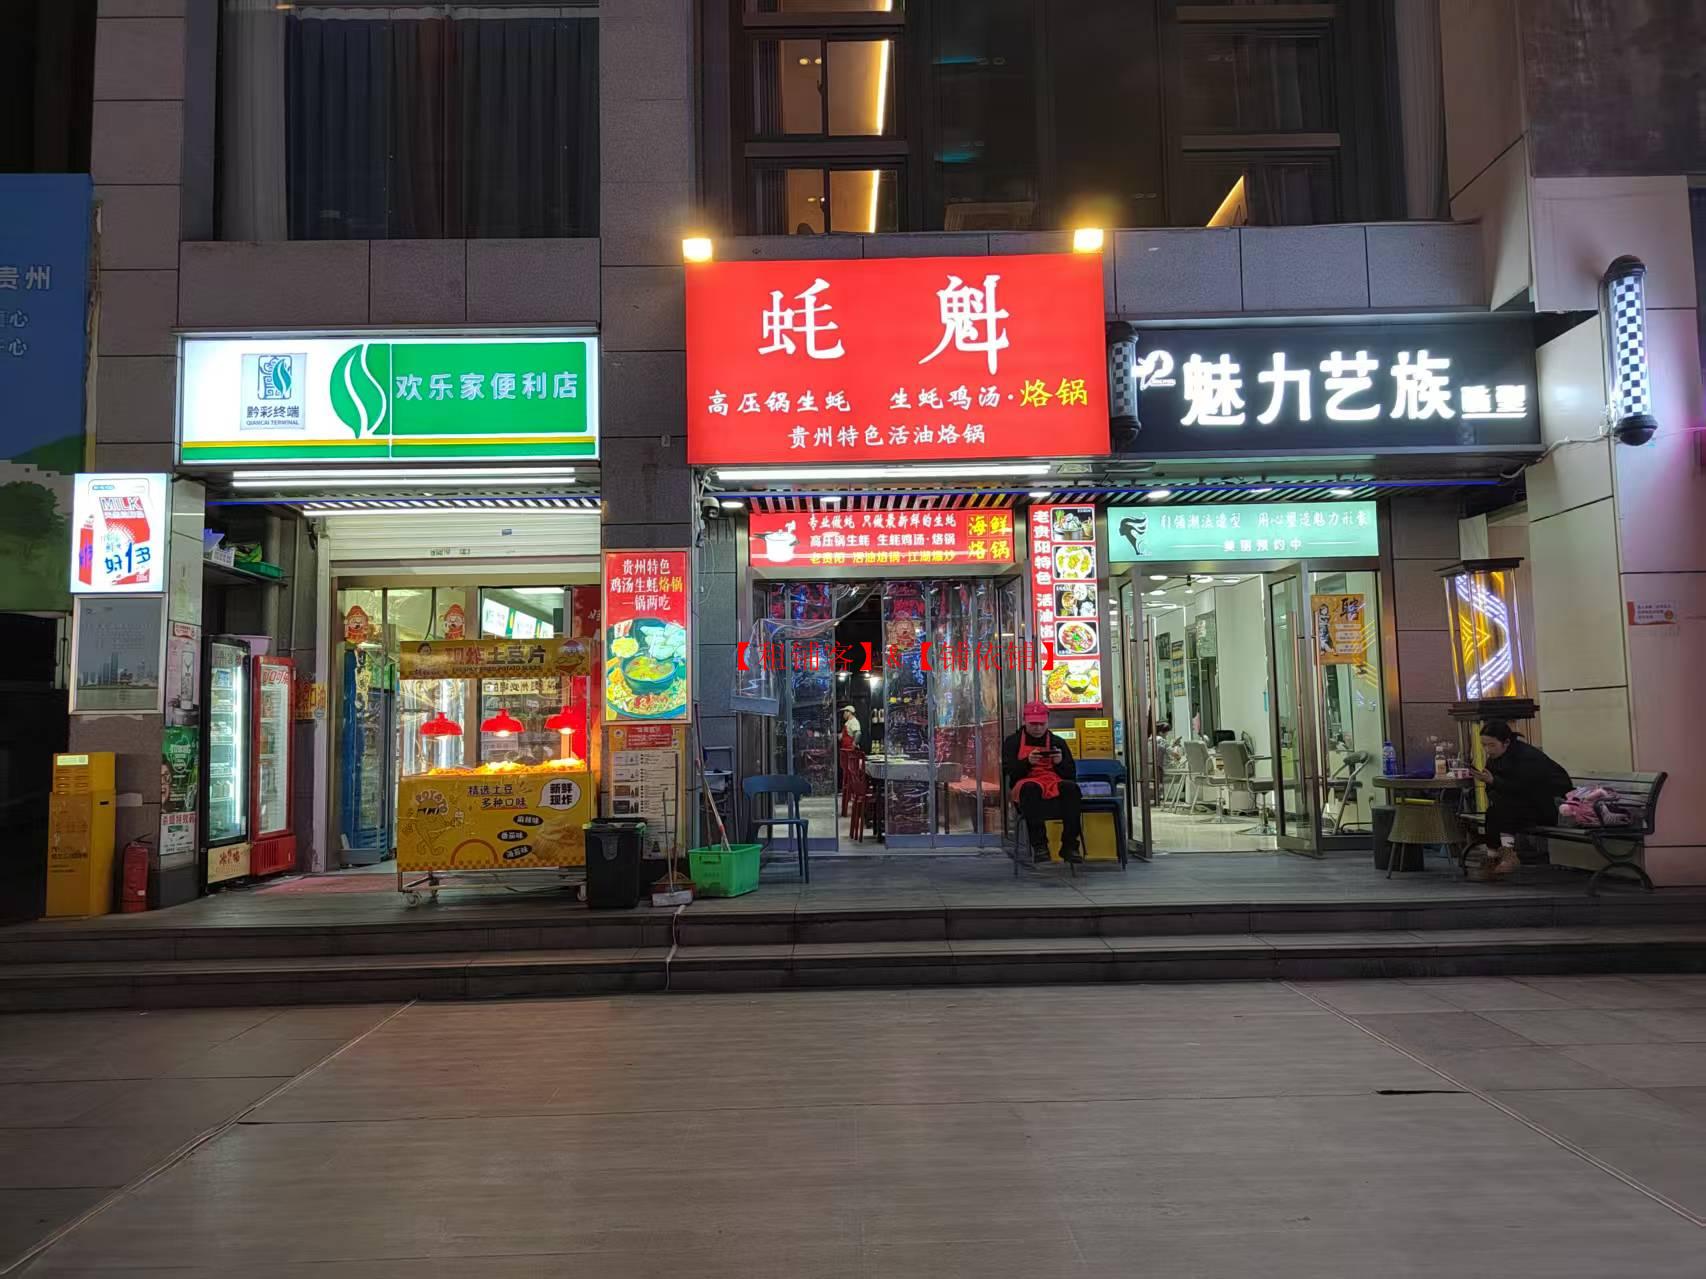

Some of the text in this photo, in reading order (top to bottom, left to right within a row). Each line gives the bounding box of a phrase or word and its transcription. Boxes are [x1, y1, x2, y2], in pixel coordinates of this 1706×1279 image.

[395, 371, 578, 401] 欢乐家便利店
[1180, 350, 1456, 426] 魅力艺族
[707, 388, 852, 417] 高压锅生蚝
[246, 405, 300, 418] 黔彩终端
[787, 423, 987, 449] 贵州特色活油烙锅
[100, 496, 144, 511] MILK
[968, 515, 1010, 537] 海鲜
[810, 535, 871, 549] 高压锅生蚝
[967, 540, 1010, 561] 烙锅
[622, 558, 670, 575] 贵州特色
[610, 576, 683, 593] 鸡汤生蚝烙锅
[622, 594, 671, 611] 一锅两吃
[468, 784, 514, 797] 精选土豆
[550, 783, 573, 794] 新鲜
[482, 797, 528, 807] 多种口味
[550, 795, 573, 806] 现炸
